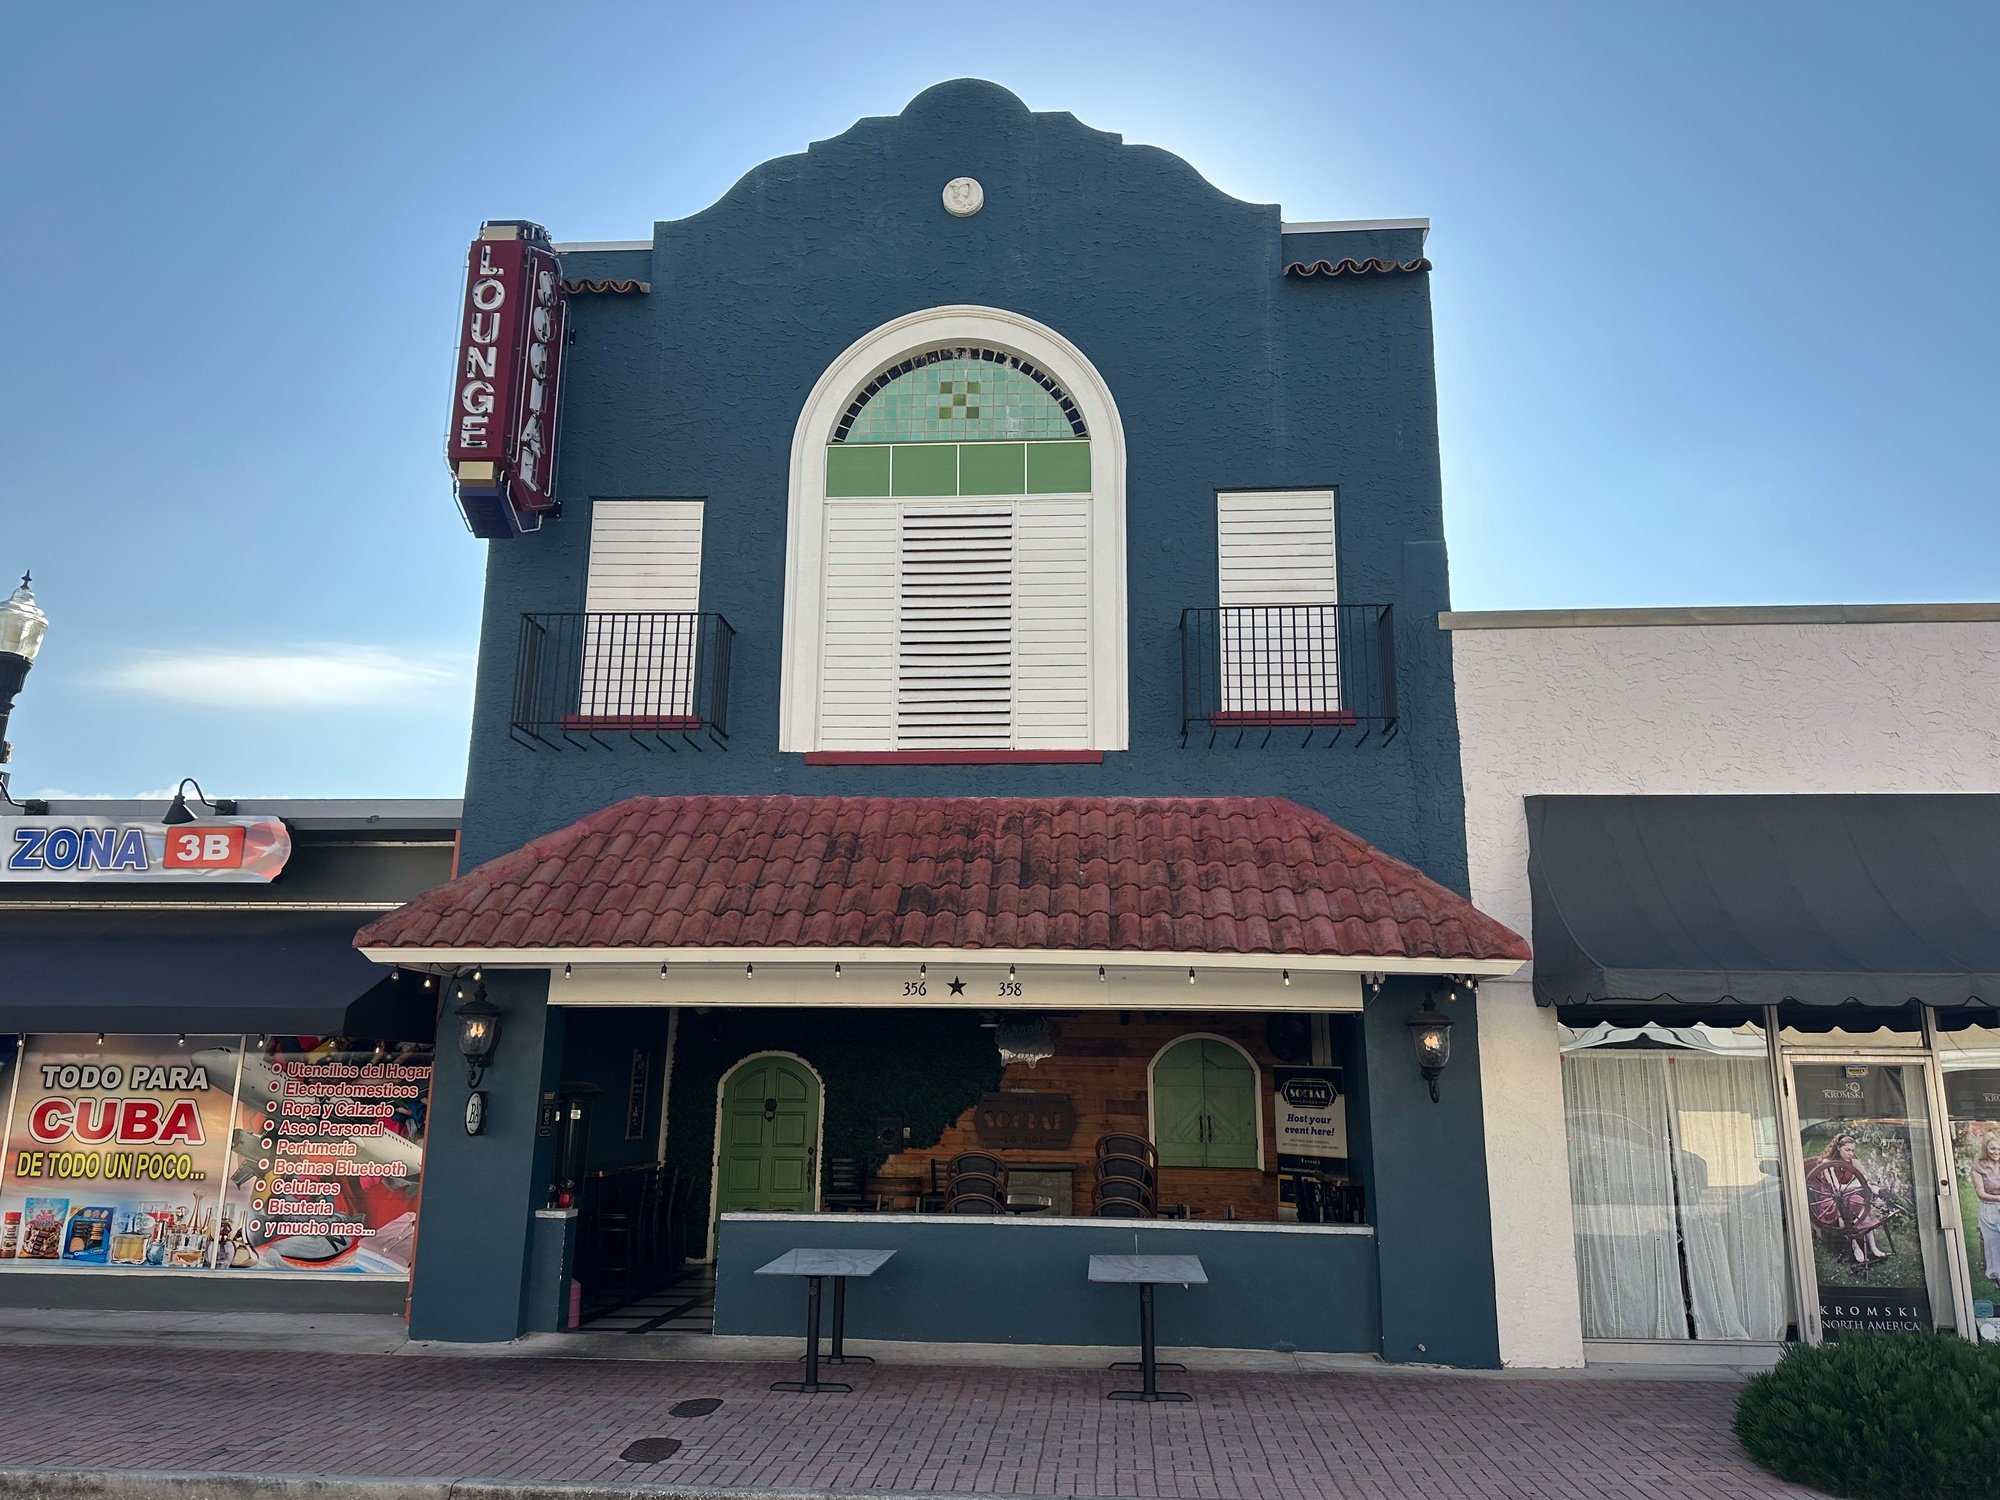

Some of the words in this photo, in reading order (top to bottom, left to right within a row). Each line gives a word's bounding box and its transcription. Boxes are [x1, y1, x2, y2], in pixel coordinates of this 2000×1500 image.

[460, 244, 505, 449] LOUNGE
[519, 270, 556, 492] SOCIAL
[9, 828, 149, 870] ZONA
[176, 834, 230, 861] 3B
[902, 981, 927, 996] 356
[998, 981, 1023, 997] 358
[42, 1065, 122, 1089] TODO
[130, 1066, 209, 1090] PARA
[287, 1062, 358, 1078] Utencilios
[361, 1064, 385, 1078] del
[386, 1065, 432, 1081] Hogar
[284, 1081, 419, 1098] Electrodomesticos
[1289, 1088, 1328, 1099] SOCIAL
[1824, 1090, 1865, 1099] KROMSKI
[282, 1101, 321, 1118] Ropa
[322, 1104, 334, 1119] y
[335, 1102, 395, 1118] Calzado
[30, 1098, 205, 1144] CUBA
[1286, 1113, 1308, 1123] Host
[1309, 1115, 1332, 1125] your
[279, 1120, 315, 1135] Aseo
[319, 1121, 384, 1137] Personal
[1284, 1126, 1310, 1135] event
[1311, 1126, 1335, 1137] here!
[277, 1139, 356, 1156] Perfumeria
[17, 1151, 44, 1177] DE
[48, 1152, 100, 1178] TODO
[104, 1153, 133, 1178] UN
[135, 1154, 205, 1180] POCO...
[274, 1159, 332, 1176] Bocinas
[335, 1160, 407, 1177] Bluetooth
[272, 1179, 340, 1195] Celulares
[268, 1199, 334, 1215] Bisuteria
[265, 1221, 278, 1237] y
[278, 1219, 327, 1236] mucho
[331, 1222, 375, 1236] mas...
[1820, 1305, 1918, 1317] KROMSKI
[1822, 1320, 1864, 1330] NORTH
[1867, 1321, 1920, 1331] AMERICA
